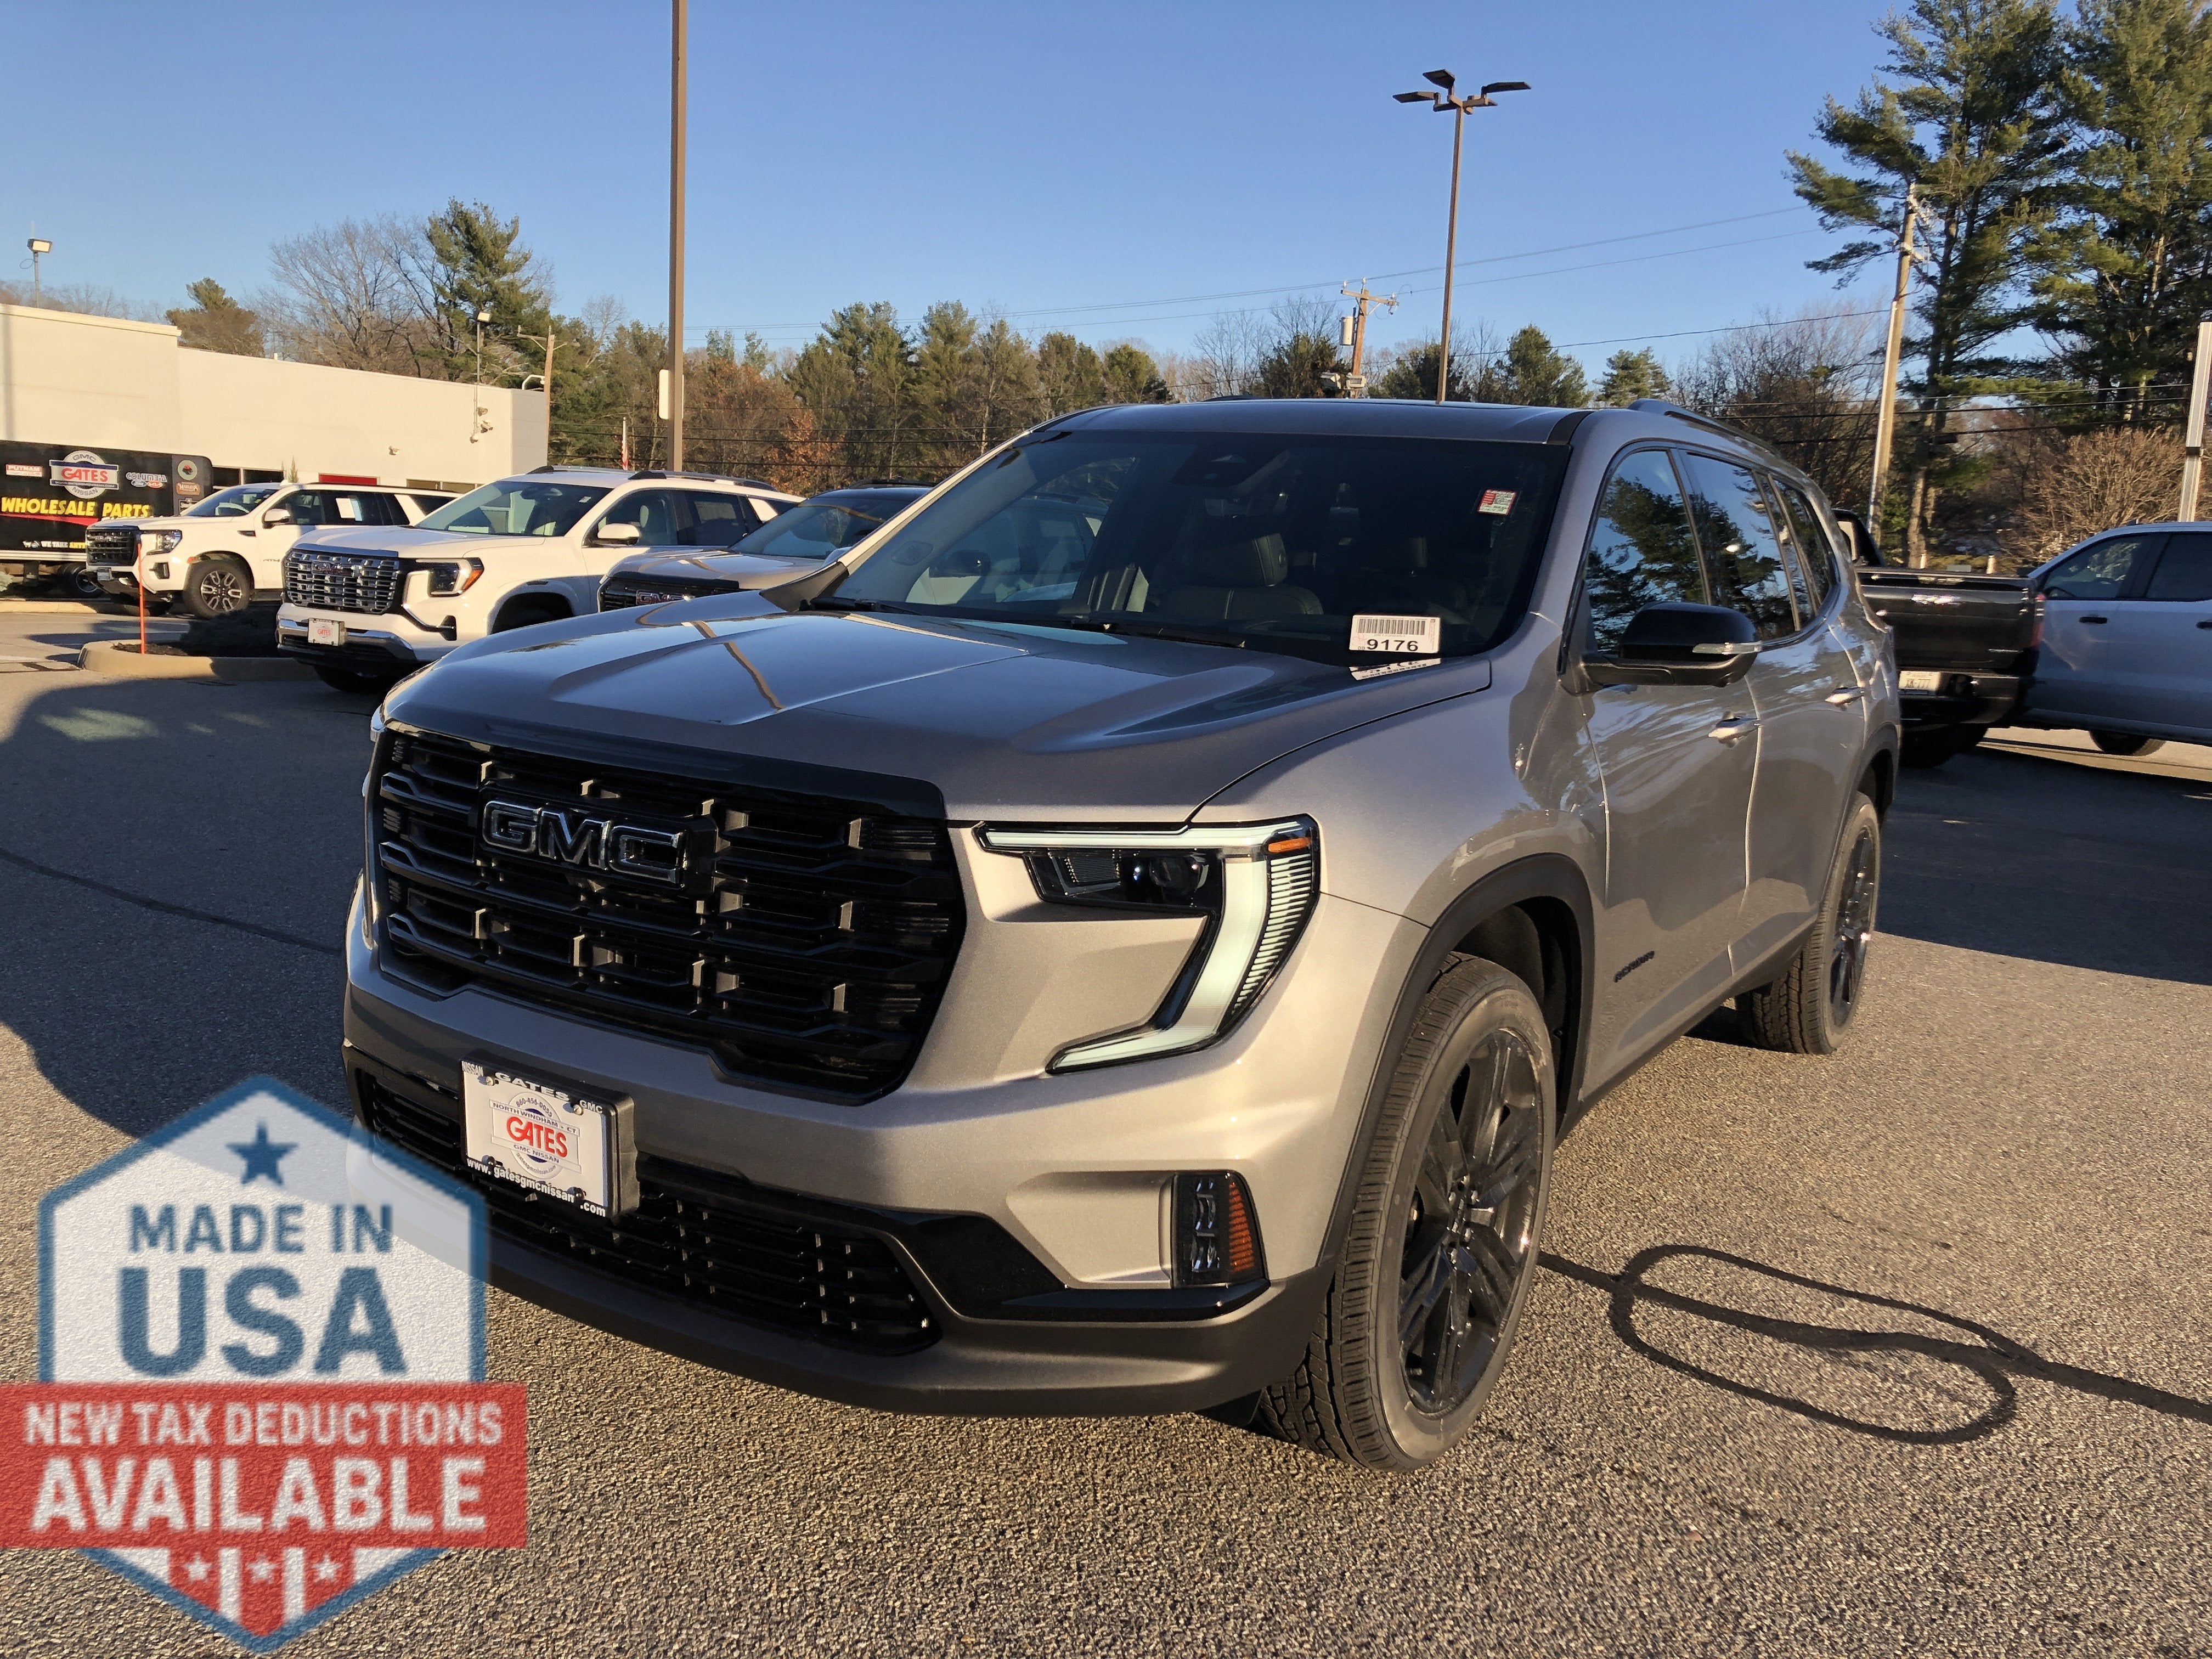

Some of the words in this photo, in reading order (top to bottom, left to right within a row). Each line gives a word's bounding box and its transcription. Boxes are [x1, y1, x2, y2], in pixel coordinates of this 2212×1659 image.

[72, 454, 97, 462] GMC
[61, 468, 108, 482] GATES
[72, 487, 98, 495] NISSAN
[1, 497, 96, 516] WHOLESALE
[102, 503, 150, 517] PARTS
[1366, 639, 1419, 652] 9176
[482, 800, 686, 885] GMC
[461, 1061, 484, 1077] NISSAN
[495, 1071, 571, 1101] GATES
[493, 1103, 520, 1114] NORTH
[520, 1110, 558, 1127] WINDHAM
[579, 1100, 603, 1114] GMC
[506, 1116, 568, 1158] GATES
[514, 1144, 531, 1153] GMC
[533, 1150, 559, 1163] NISSAN
